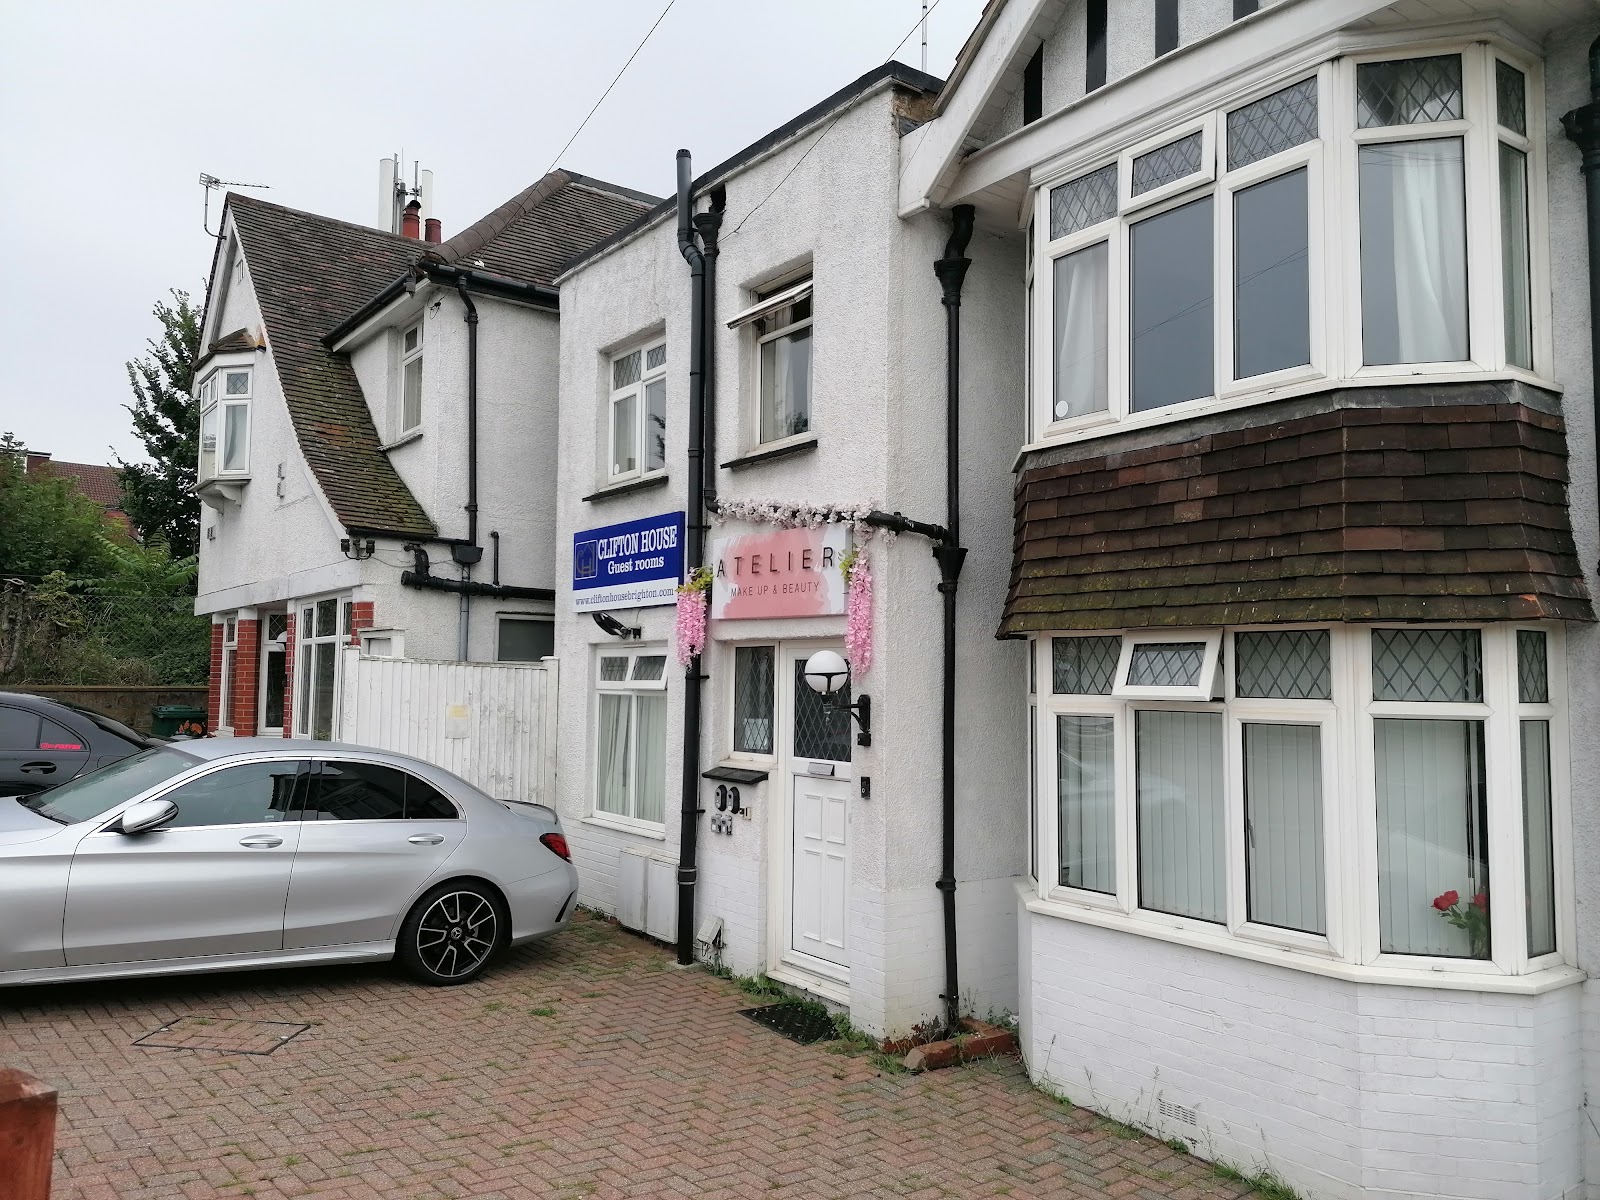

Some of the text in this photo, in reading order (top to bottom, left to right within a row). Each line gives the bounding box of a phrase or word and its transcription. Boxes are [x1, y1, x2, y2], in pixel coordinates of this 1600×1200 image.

[598, 525, 678, 560] CLIFTON HOUSE
[607, 556, 664, 574] Guest rooms
[716, 546, 835, 578] ATELIER
[575, 588, 674, 606] www.cliftonhousebrighton.com
[730, 581, 821, 598] MAKE UP & BEAUTY
